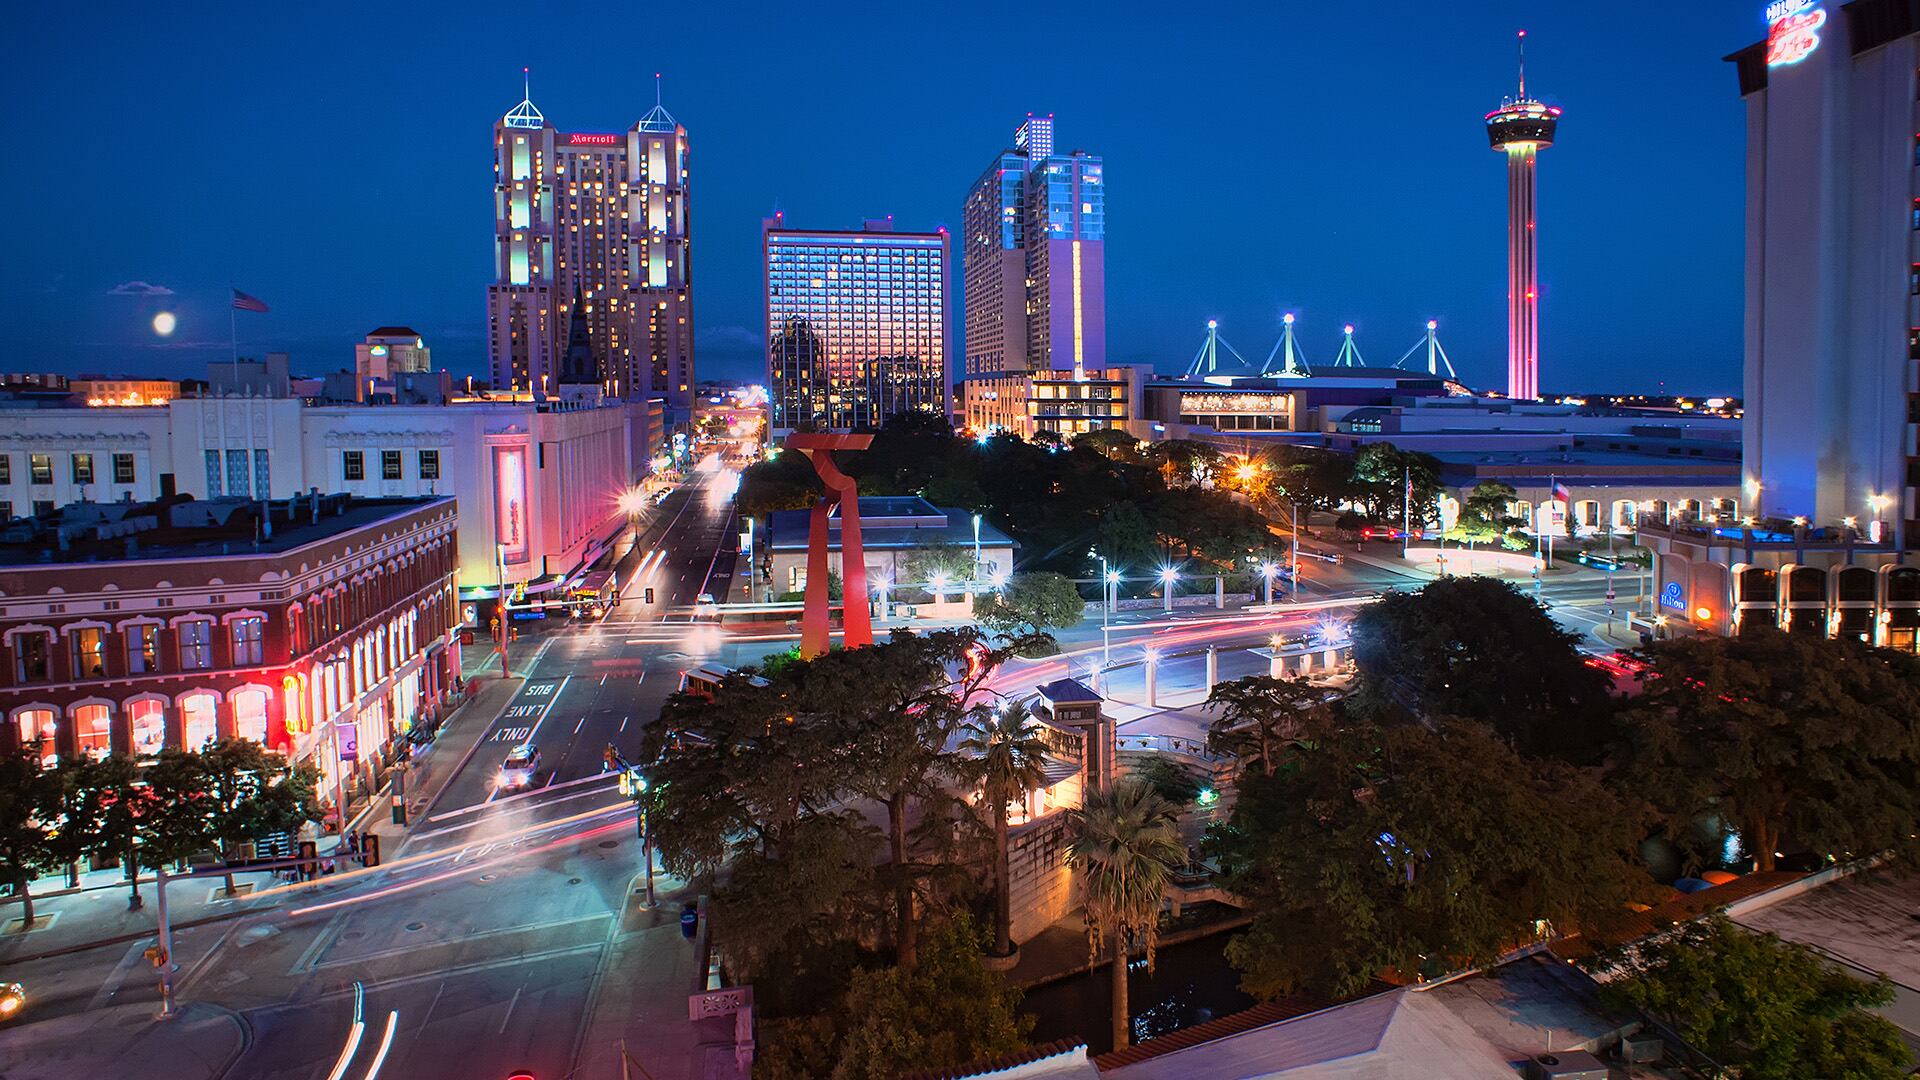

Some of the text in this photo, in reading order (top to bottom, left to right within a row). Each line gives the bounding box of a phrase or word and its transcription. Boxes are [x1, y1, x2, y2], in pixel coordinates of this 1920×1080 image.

[570, 134, 616, 143] Marriott
[1661, 594, 1684, 609] Hilton
[525, 684, 554, 695] BUS
[505, 704, 546, 717] LANE
[490, 727, 530, 741] ONLY
